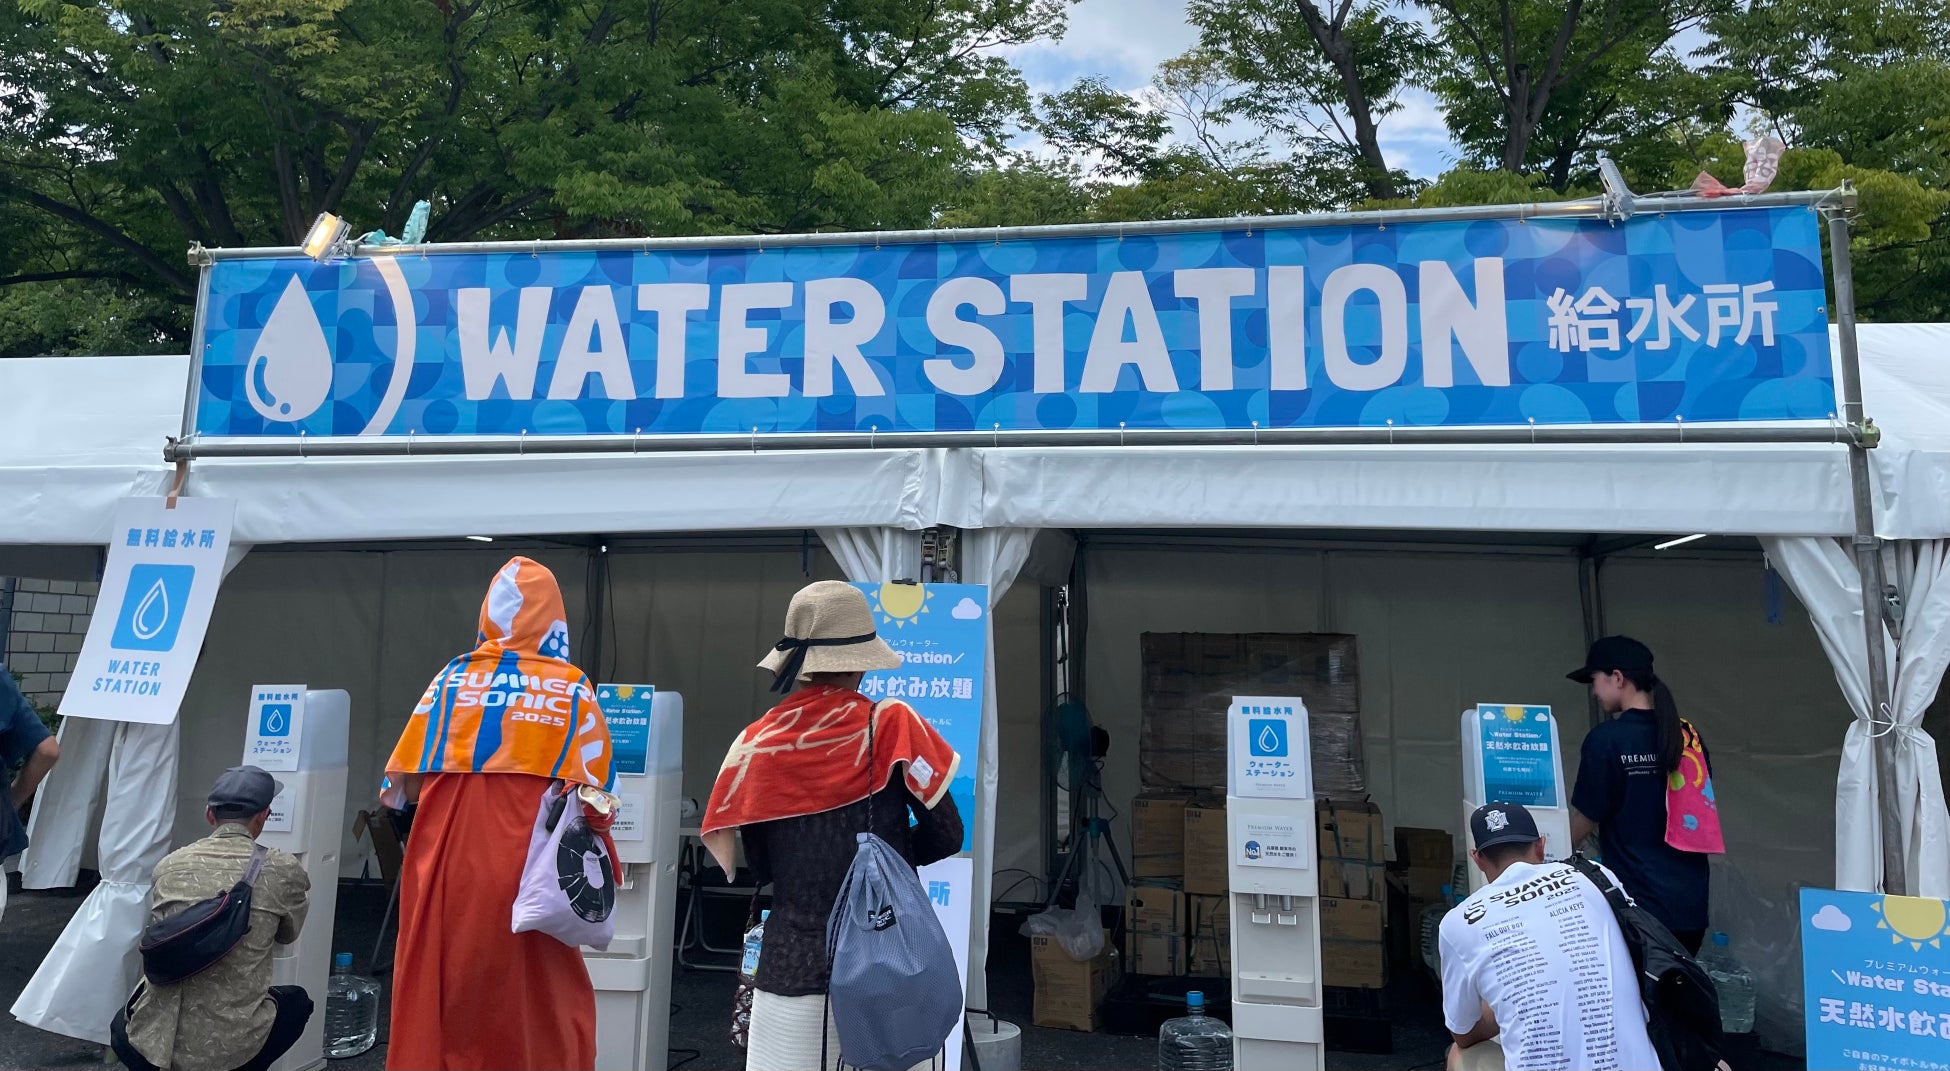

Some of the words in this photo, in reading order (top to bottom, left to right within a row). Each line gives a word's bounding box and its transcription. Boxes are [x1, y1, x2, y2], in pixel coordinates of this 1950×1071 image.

[1547, 280, 1778, 352] 給水所
[457, 277, 885, 400] WATER
[924, 256, 1511, 396] STATION
[126, 528, 216, 548] 無料給水所
[108, 659, 161, 676] WATER
[93, 677, 161, 696] STATION
[446, 672, 590, 704] SUMMER
[855, 675, 973, 699] 水飲み放題
[456, 690, 572, 713] SONIC
[511, 711, 566, 726] 2025
[1246, 769, 1295, 778] ステーション
[1489, 867, 1580, 903] SUMMER
[1504, 876, 1579, 908] SONIC
[1547, 885, 1580, 901] 2025
[1549, 905, 1569, 918] ALICIA
[1569, 902, 1585, 912] KEYS
[1485, 926, 1500, 940] FALL
[1846, 970, 1905, 992] Water
